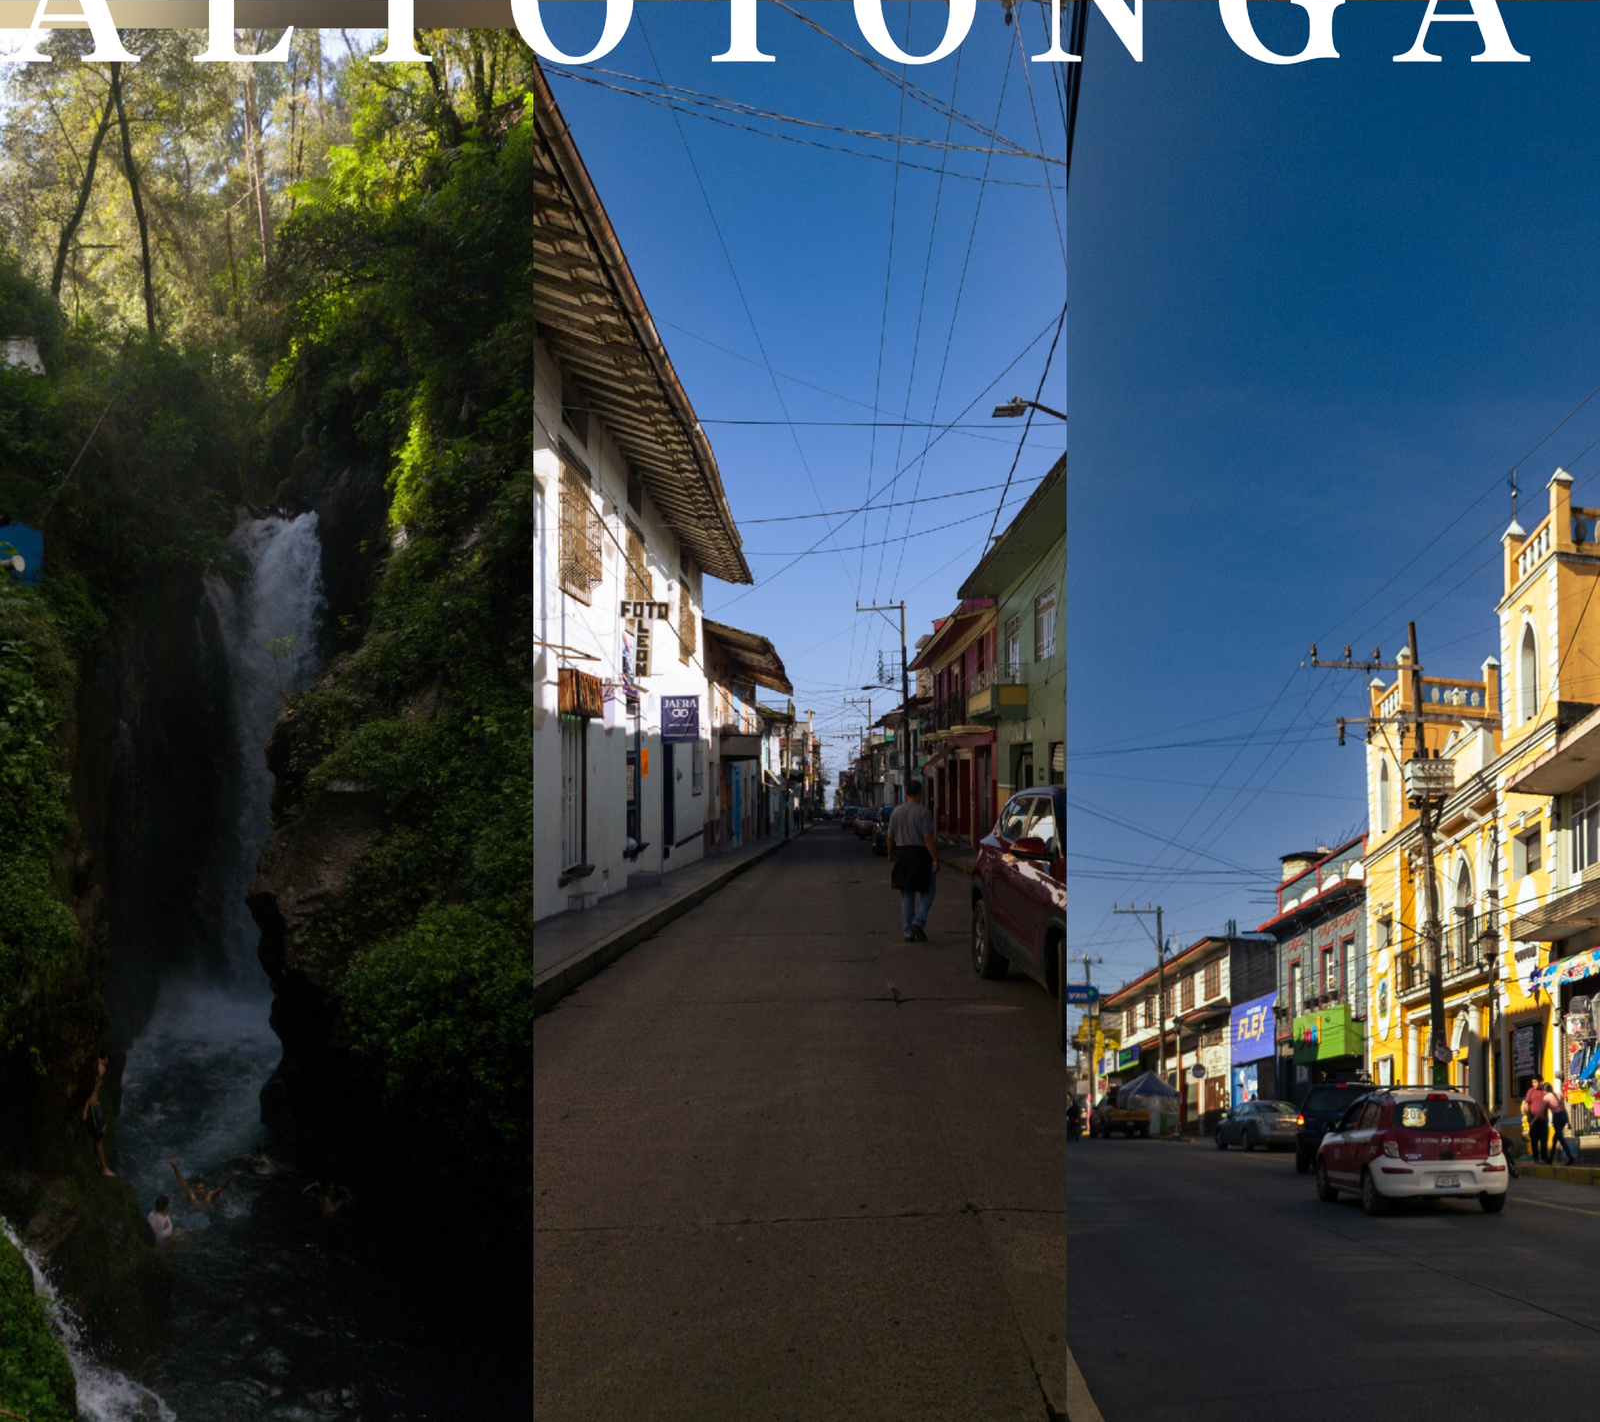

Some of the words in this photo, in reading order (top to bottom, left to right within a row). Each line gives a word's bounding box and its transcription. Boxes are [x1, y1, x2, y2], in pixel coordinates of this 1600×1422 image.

[621, 601, 668, 619] FOTO
[636, 619, 650, 676] LEON
[663, 699, 697, 709] JAFRA
[1238, 1005, 1268, 1042] FLEX
